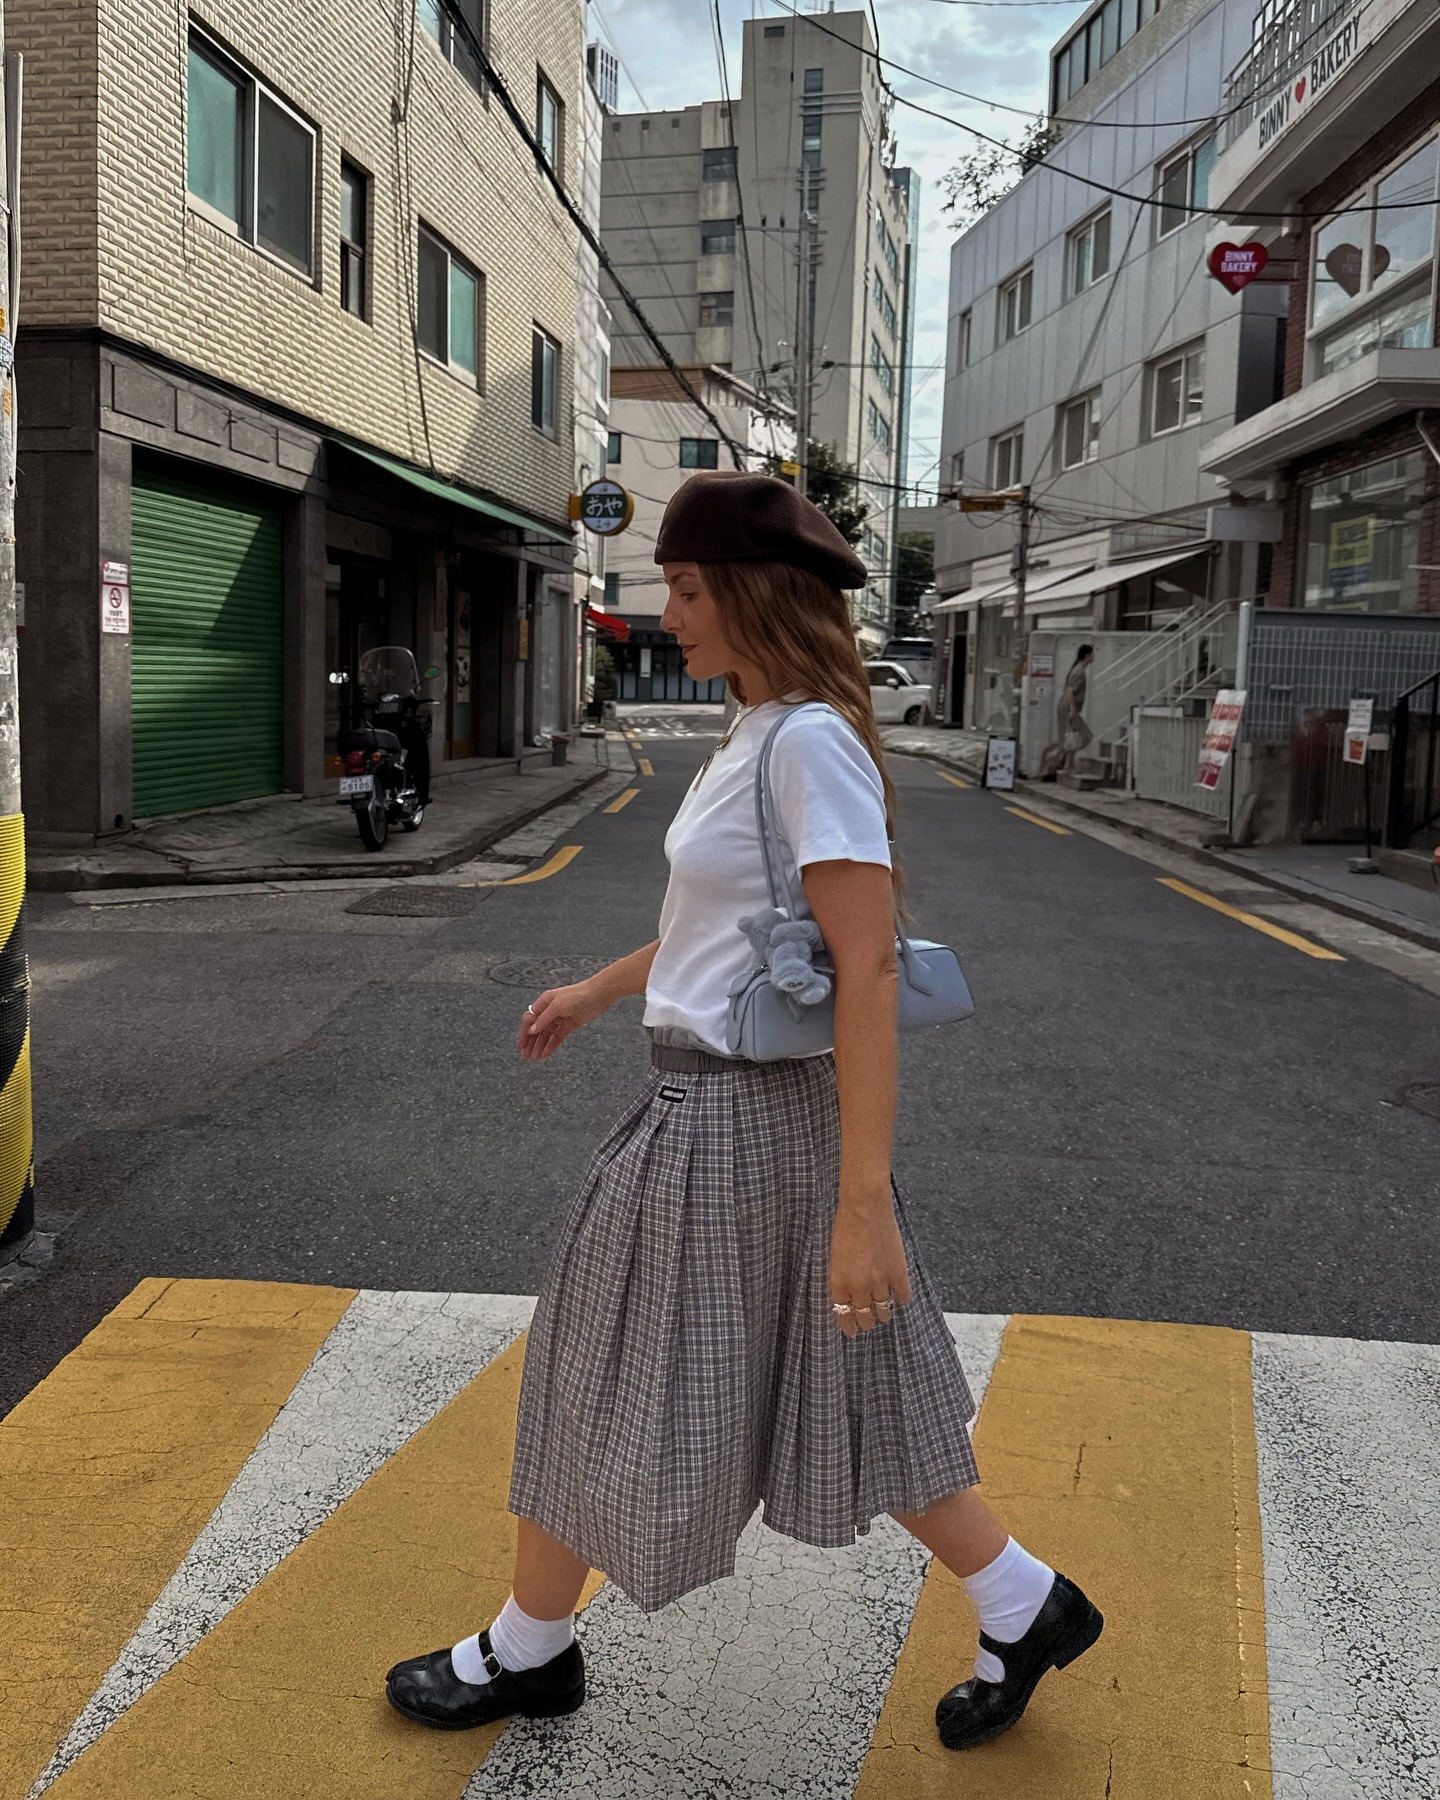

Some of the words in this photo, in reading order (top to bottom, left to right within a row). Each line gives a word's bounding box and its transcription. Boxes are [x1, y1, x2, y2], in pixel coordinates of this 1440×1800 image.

[1259, 85, 1292, 150] BINNY
[1310, 9, 1361, 97] BAKERY
[1225, 250, 1255, 262] BINNY
[1221, 261, 1258, 273] BAKERY
[586, 495, 623, 517] おや
